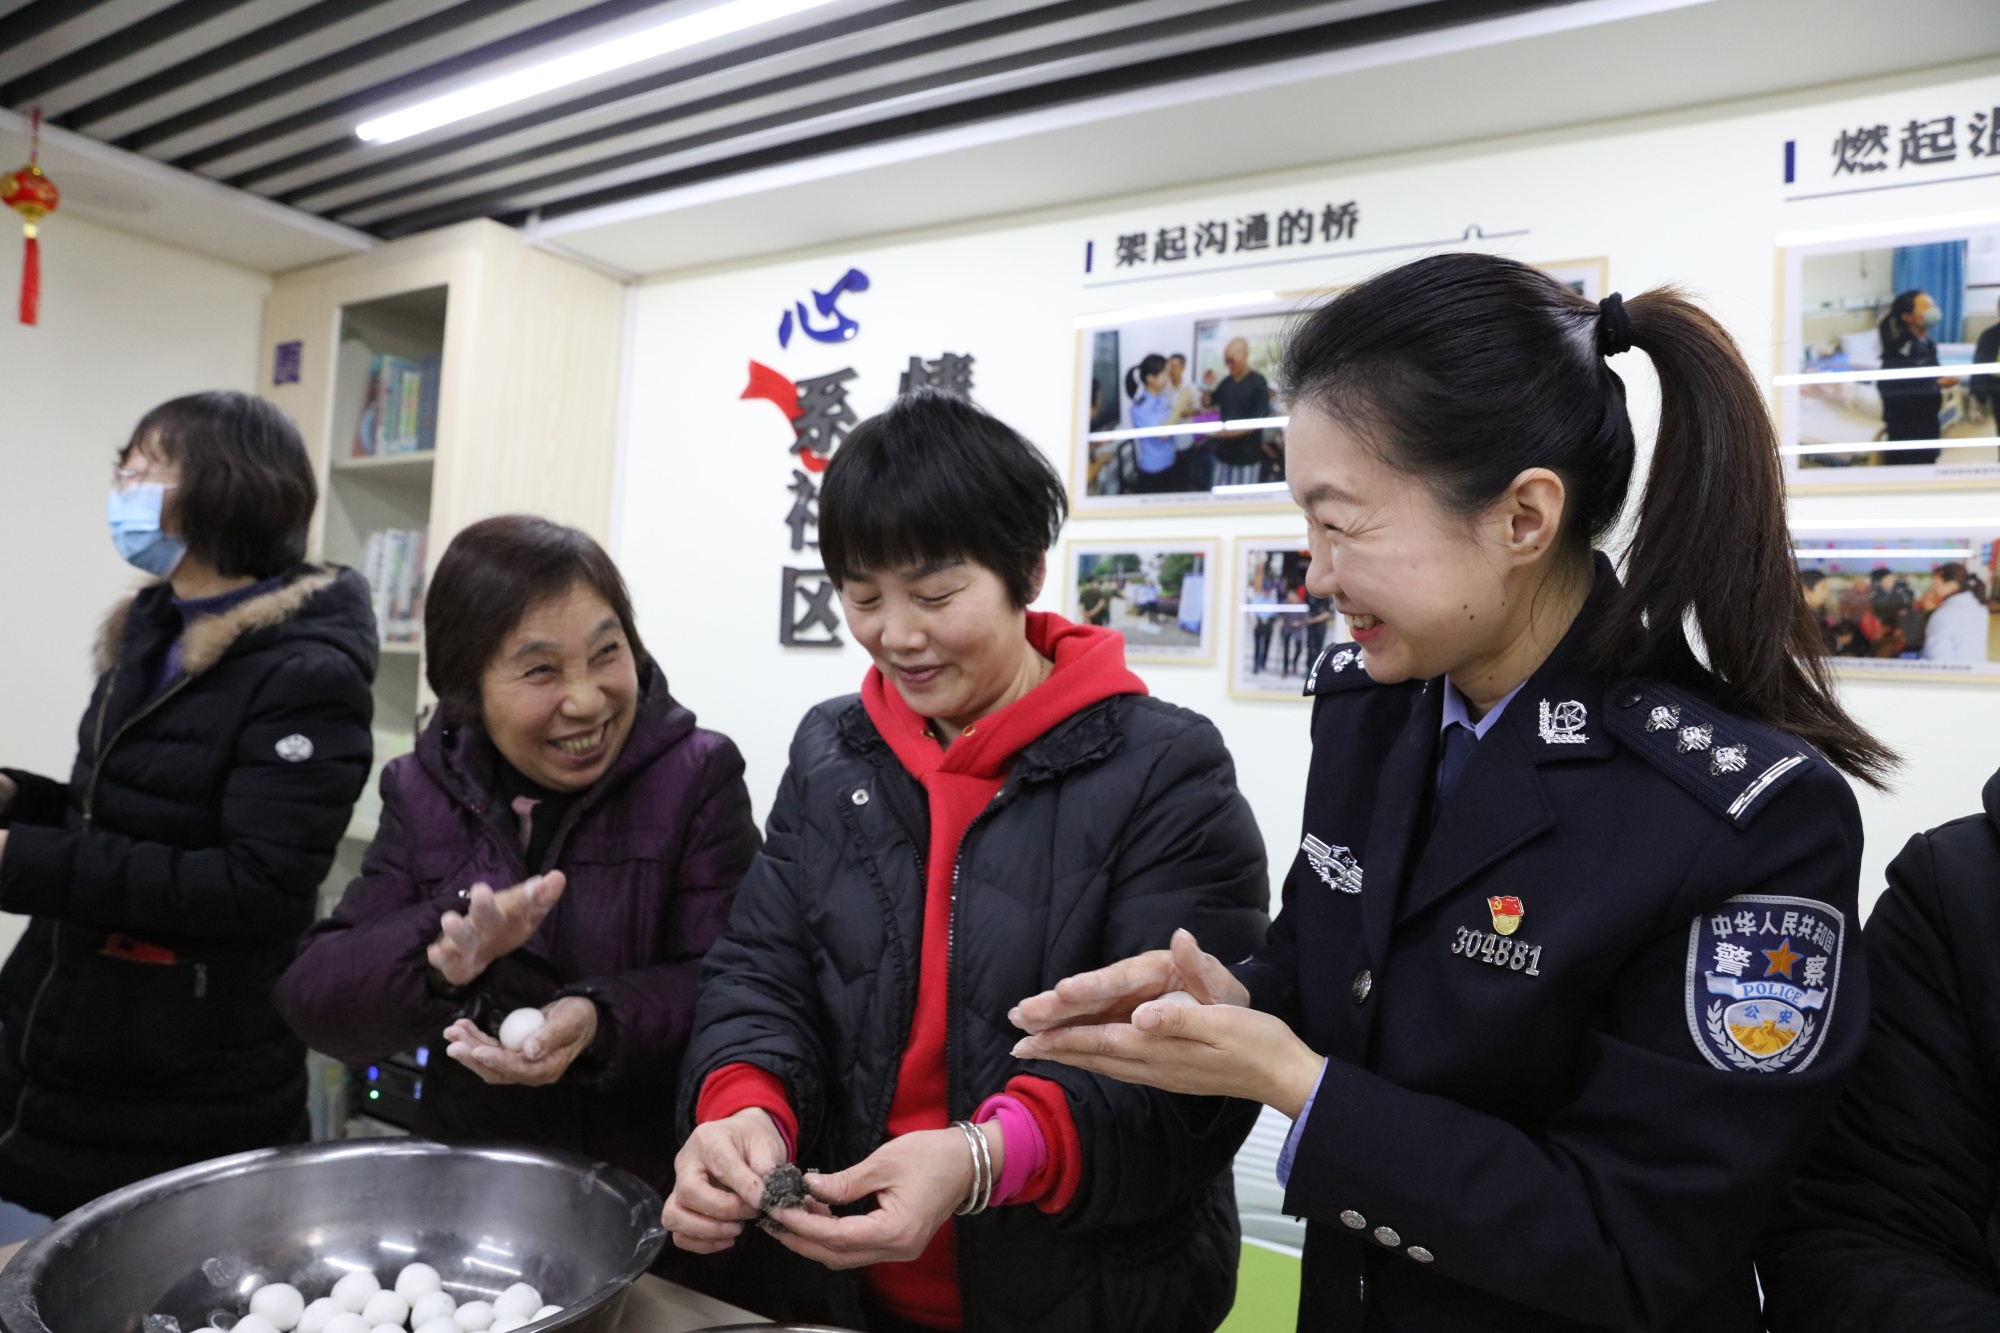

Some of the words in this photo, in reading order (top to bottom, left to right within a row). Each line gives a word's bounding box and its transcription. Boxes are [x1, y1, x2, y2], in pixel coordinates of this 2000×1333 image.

[1115, 201, 1360, 268] 架起沟通的桥
[1452, 926, 1541, 976] 304881
[1711, 911, 1835, 954] 中华人民共和国
[1743, 984, 1803, 1005] POLICE
